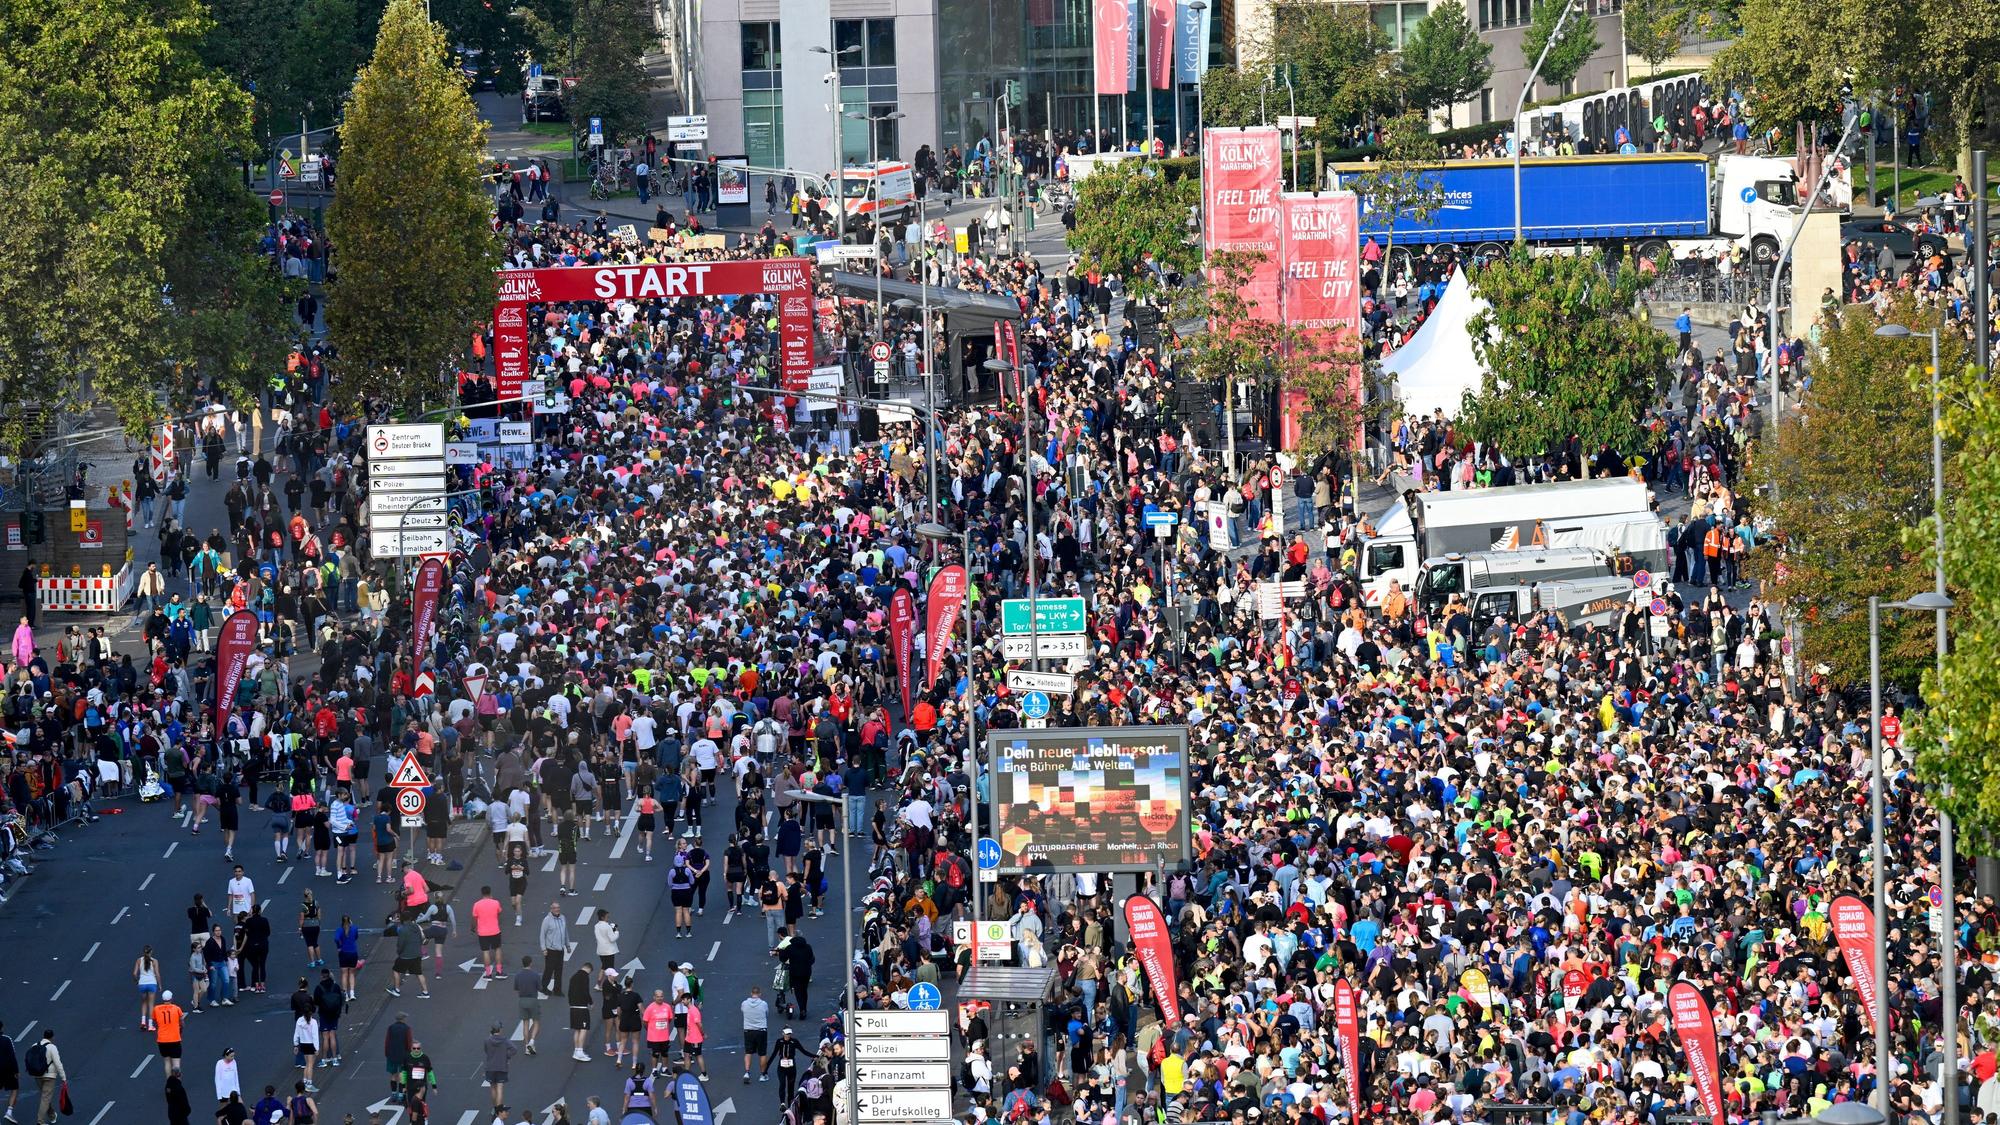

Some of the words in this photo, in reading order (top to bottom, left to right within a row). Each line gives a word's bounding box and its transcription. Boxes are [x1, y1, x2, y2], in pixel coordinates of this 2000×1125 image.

[1220, 145, 1253, 161] KÖLN
[1220, 162, 1253, 171] MARATHON
[1217, 190, 1244, 206] FEEL
[1249, 189, 1271, 205] THE
[1248, 208, 1276, 223] CITY
[1292, 213, 1327, 231] KÖLN
[1292, 231, 1328, 240] MARATHON
[1232, 242, 1276, 251] GENERAL
[1288, 262, 1319, 279] FEEL
[1324, 261, 1347, 277] THE
[595, 265, 711, 298] START
[763, 268, 792, 284] KÖLN
[763, 284, 792, 292] MARATHON
[1323, 281, 1352, 298] CITY
[810, 382, 830, 390] REWE
[946, 576, 957, 584] ROT
[1590, 600, 1613, 614] AWB
[236, 623, 247, 631] ROT
[235, 632, 246, 640] RED
[1017, 644, 1032, 652] P2
[1060, 642, 1074, 651] 3,5
[1003, 746, 1034, 760] Dein
[1038, 747, 1078, 759] neuer
[1082, 744, 1173, 760] Lieblingsort.
[1004, 762, 1027, 772] Eine
[1030, 761, 1068, 772] Bühne.
[1071, 761, 1091, 771] Alle
[1094, 760, 1135, 770] Welten.
[402, 795, 419, 808] 30
[1144, 812, 1173, 821] Tickets
[1027, 843, 1100, 852] KULTURRAFFINERIE
[1157, 842, 1178, 850] Rhein
[956, 928, 967, 940] C
[991, 927, 1000, 937] H
[1679, 925, 1693, 940] 25
[1469, 983, 1489, 993] 2:45
[1563, 986, 1582, 997] 2:45
[161, 1011, 171, 1024] 11
[867, 1018, 888, 1028] Poll
[866, 1044, 898, 1053] Polizei
[870, 1070, 925, 1080] Finanzamt
[871, 1094, 893, 1104] DJH
[872, 1106, 940, 1117] Berufskolleg
